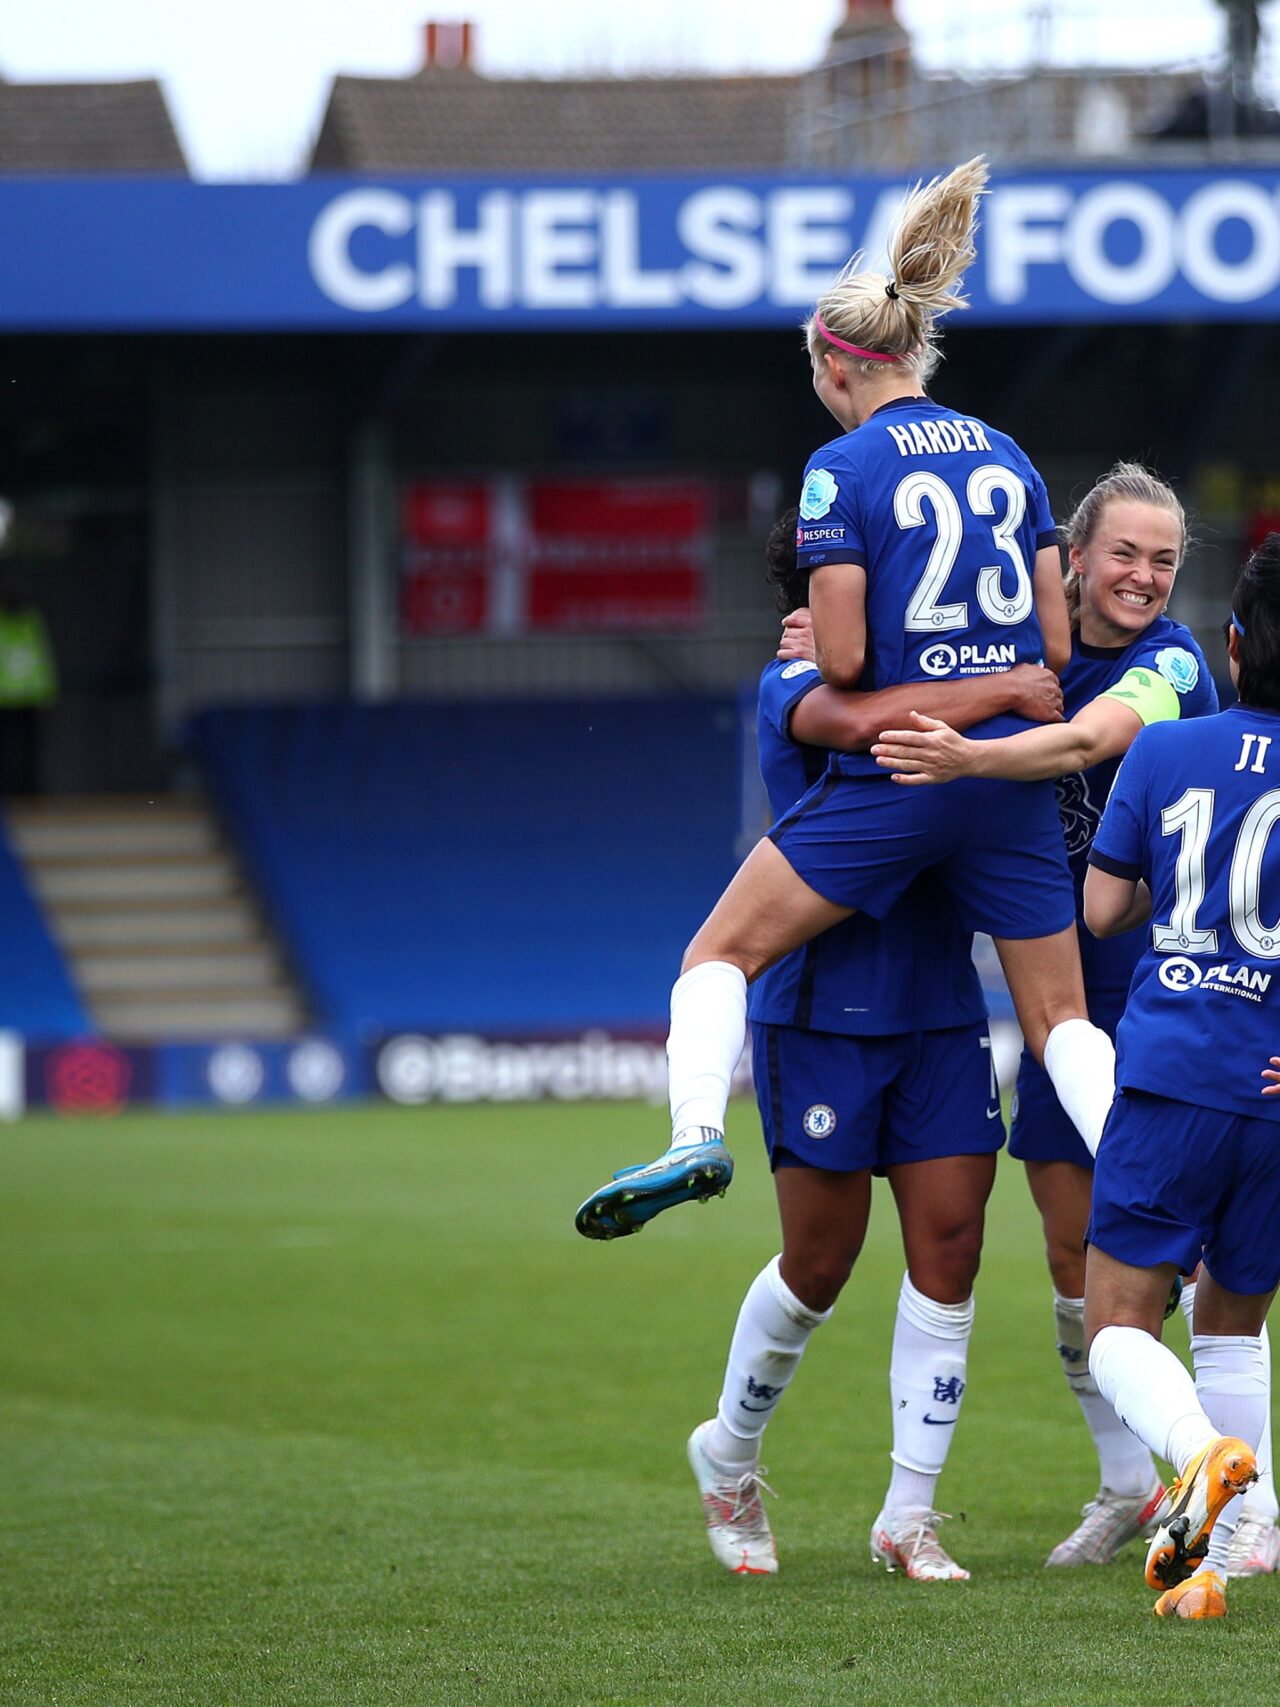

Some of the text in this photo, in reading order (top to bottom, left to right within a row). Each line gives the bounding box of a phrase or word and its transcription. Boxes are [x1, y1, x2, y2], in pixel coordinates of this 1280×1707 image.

[887, 420, 992, 456] HARDER
[804, 529, 845, 541] RESPECT
[893, 465, 1035, 632] 23
[960, 644, 1016, 664] PLAN
[959, 665, 1012, 674] INTERNATION
[1235, 734, 1272, 773] JI
[1203, 964, 1272, 992] PLAN
[1200, 982, 1262, 1003] INTERNATIONAL
